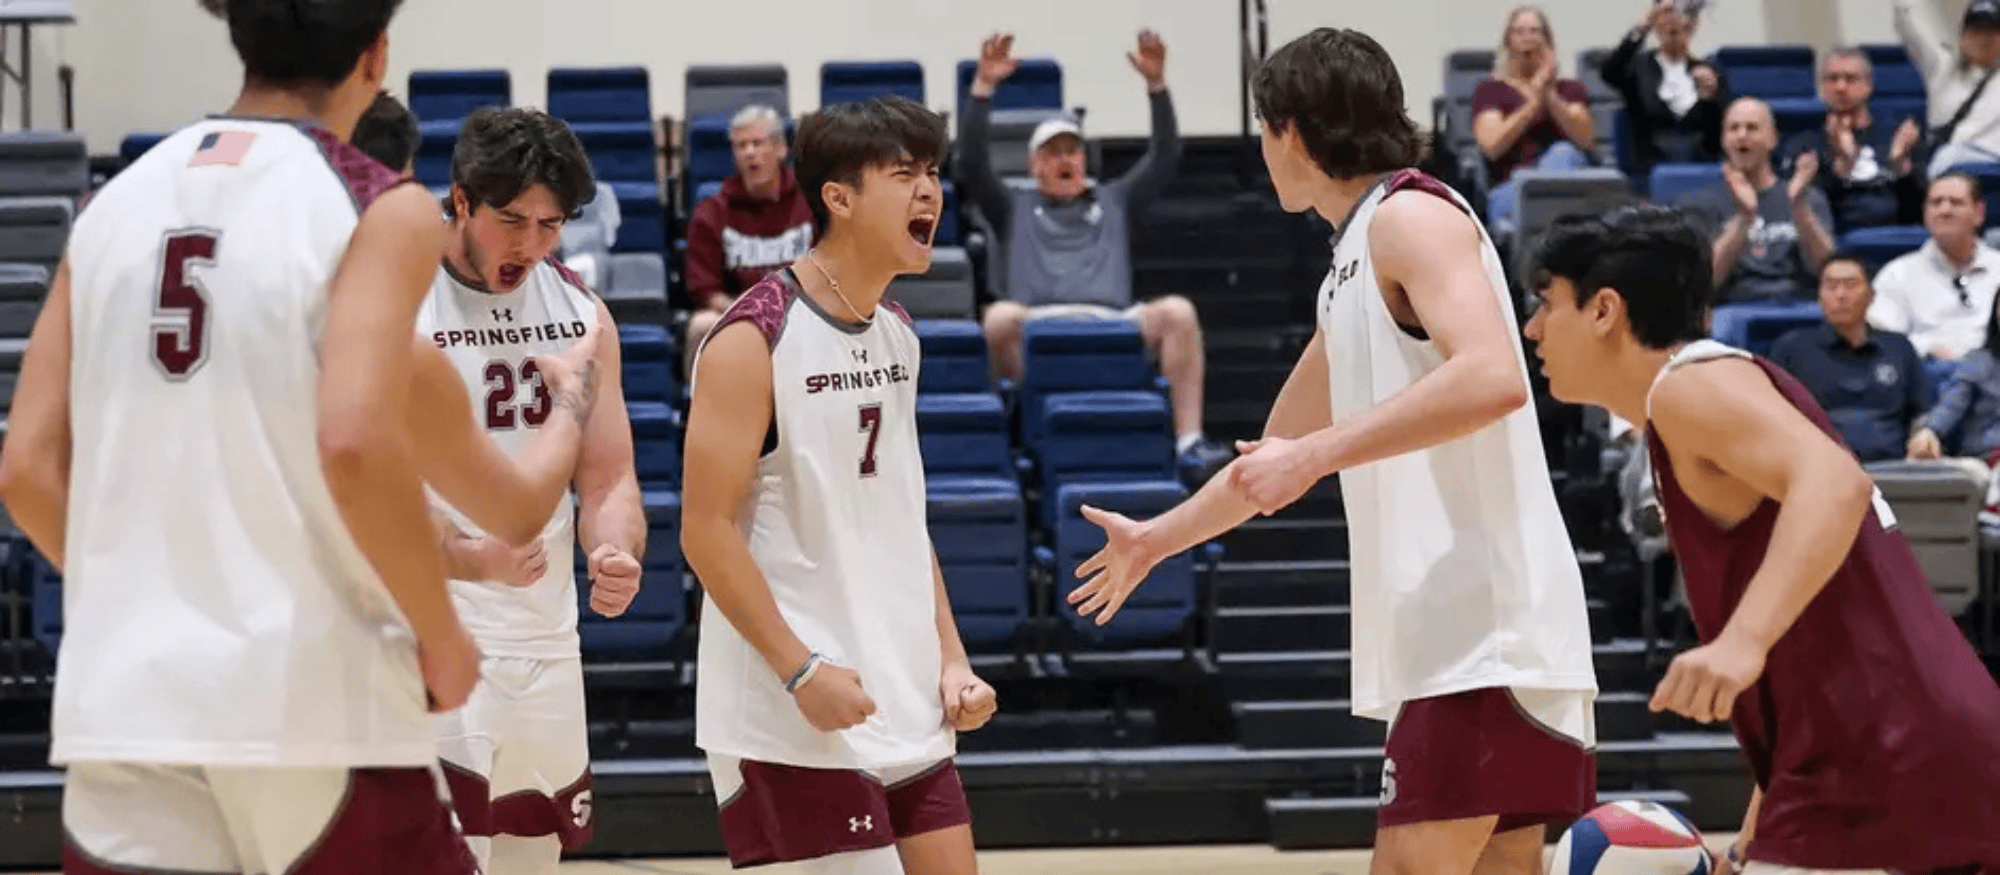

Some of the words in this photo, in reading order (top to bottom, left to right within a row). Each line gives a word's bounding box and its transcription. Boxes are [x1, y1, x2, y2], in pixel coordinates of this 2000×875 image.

[149, 226, 222, 383] 5
[433, 321, 586, 348] SPRINGFIELD
[483, 357, 553, 432] 23
[857, 401, 882, 478] 7
[571, 789, 592, 828] S
